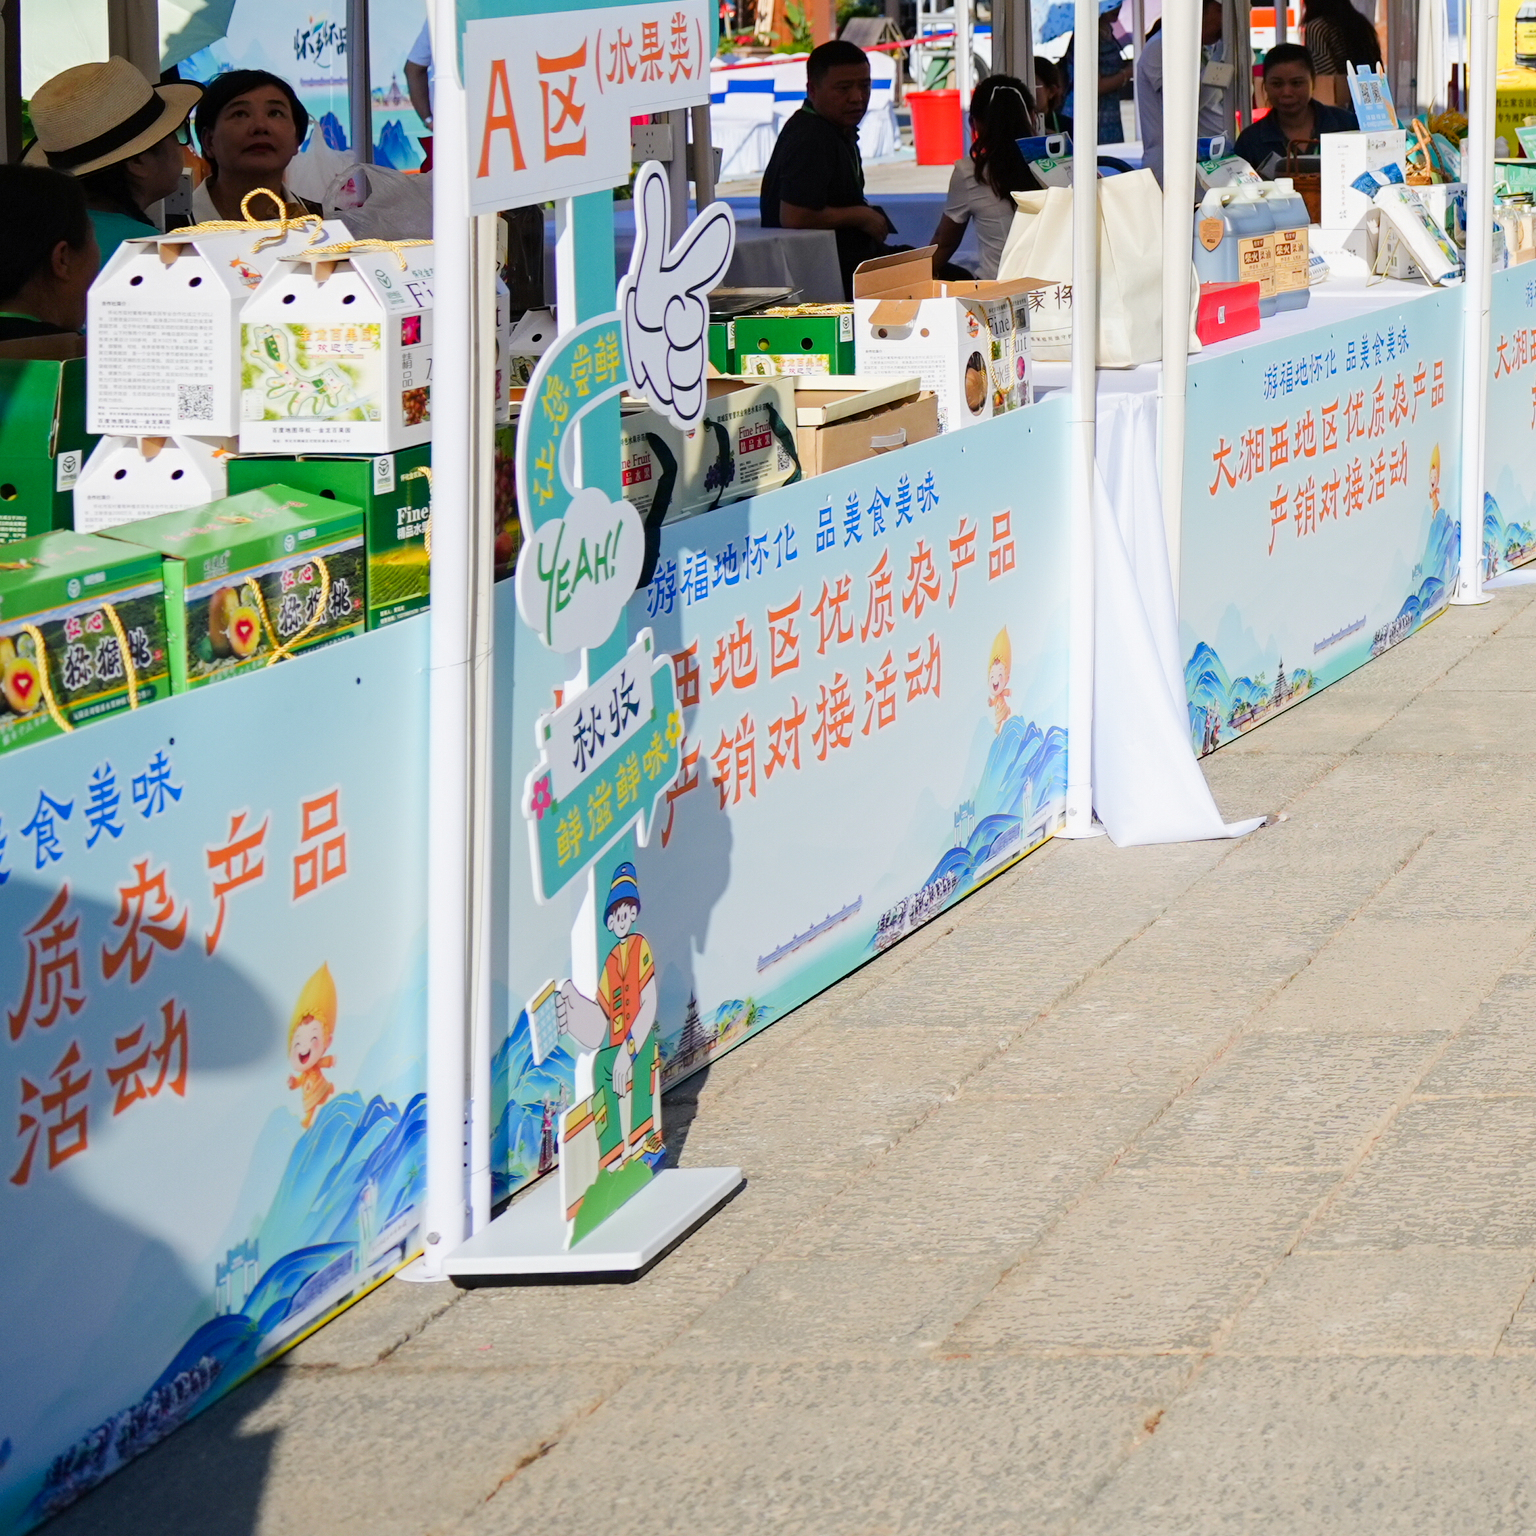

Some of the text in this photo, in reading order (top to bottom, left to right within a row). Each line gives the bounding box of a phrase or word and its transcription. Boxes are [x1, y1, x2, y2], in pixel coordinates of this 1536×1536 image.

[476, 36, 587, 178] A区
[533, 330, 621, 506] 让您尝鲜
[739, 423, 753, 438] Fine
[1207, 359, 1446, 497] 大湘西地区优质农产品
[1262, 323, 1410, 401] 游福地怀化 品美食美味
[537, 519, 623, 614] YEAH!
[645, 465, 942, 619] 游福地怀化 品美食美味
[1267, 440, 1410, 557] 产销对接活动
[64, 611, 104, 643] 红心
[571, 669, 643, 773] 秋收
[658, 633, 943, 849] 产销对接活动
[553, 728, 670, 869] 鲜滋鲜味
[9, 787, 349, 1041] 质农产品
[9, 997, 189, 1188] 活动
